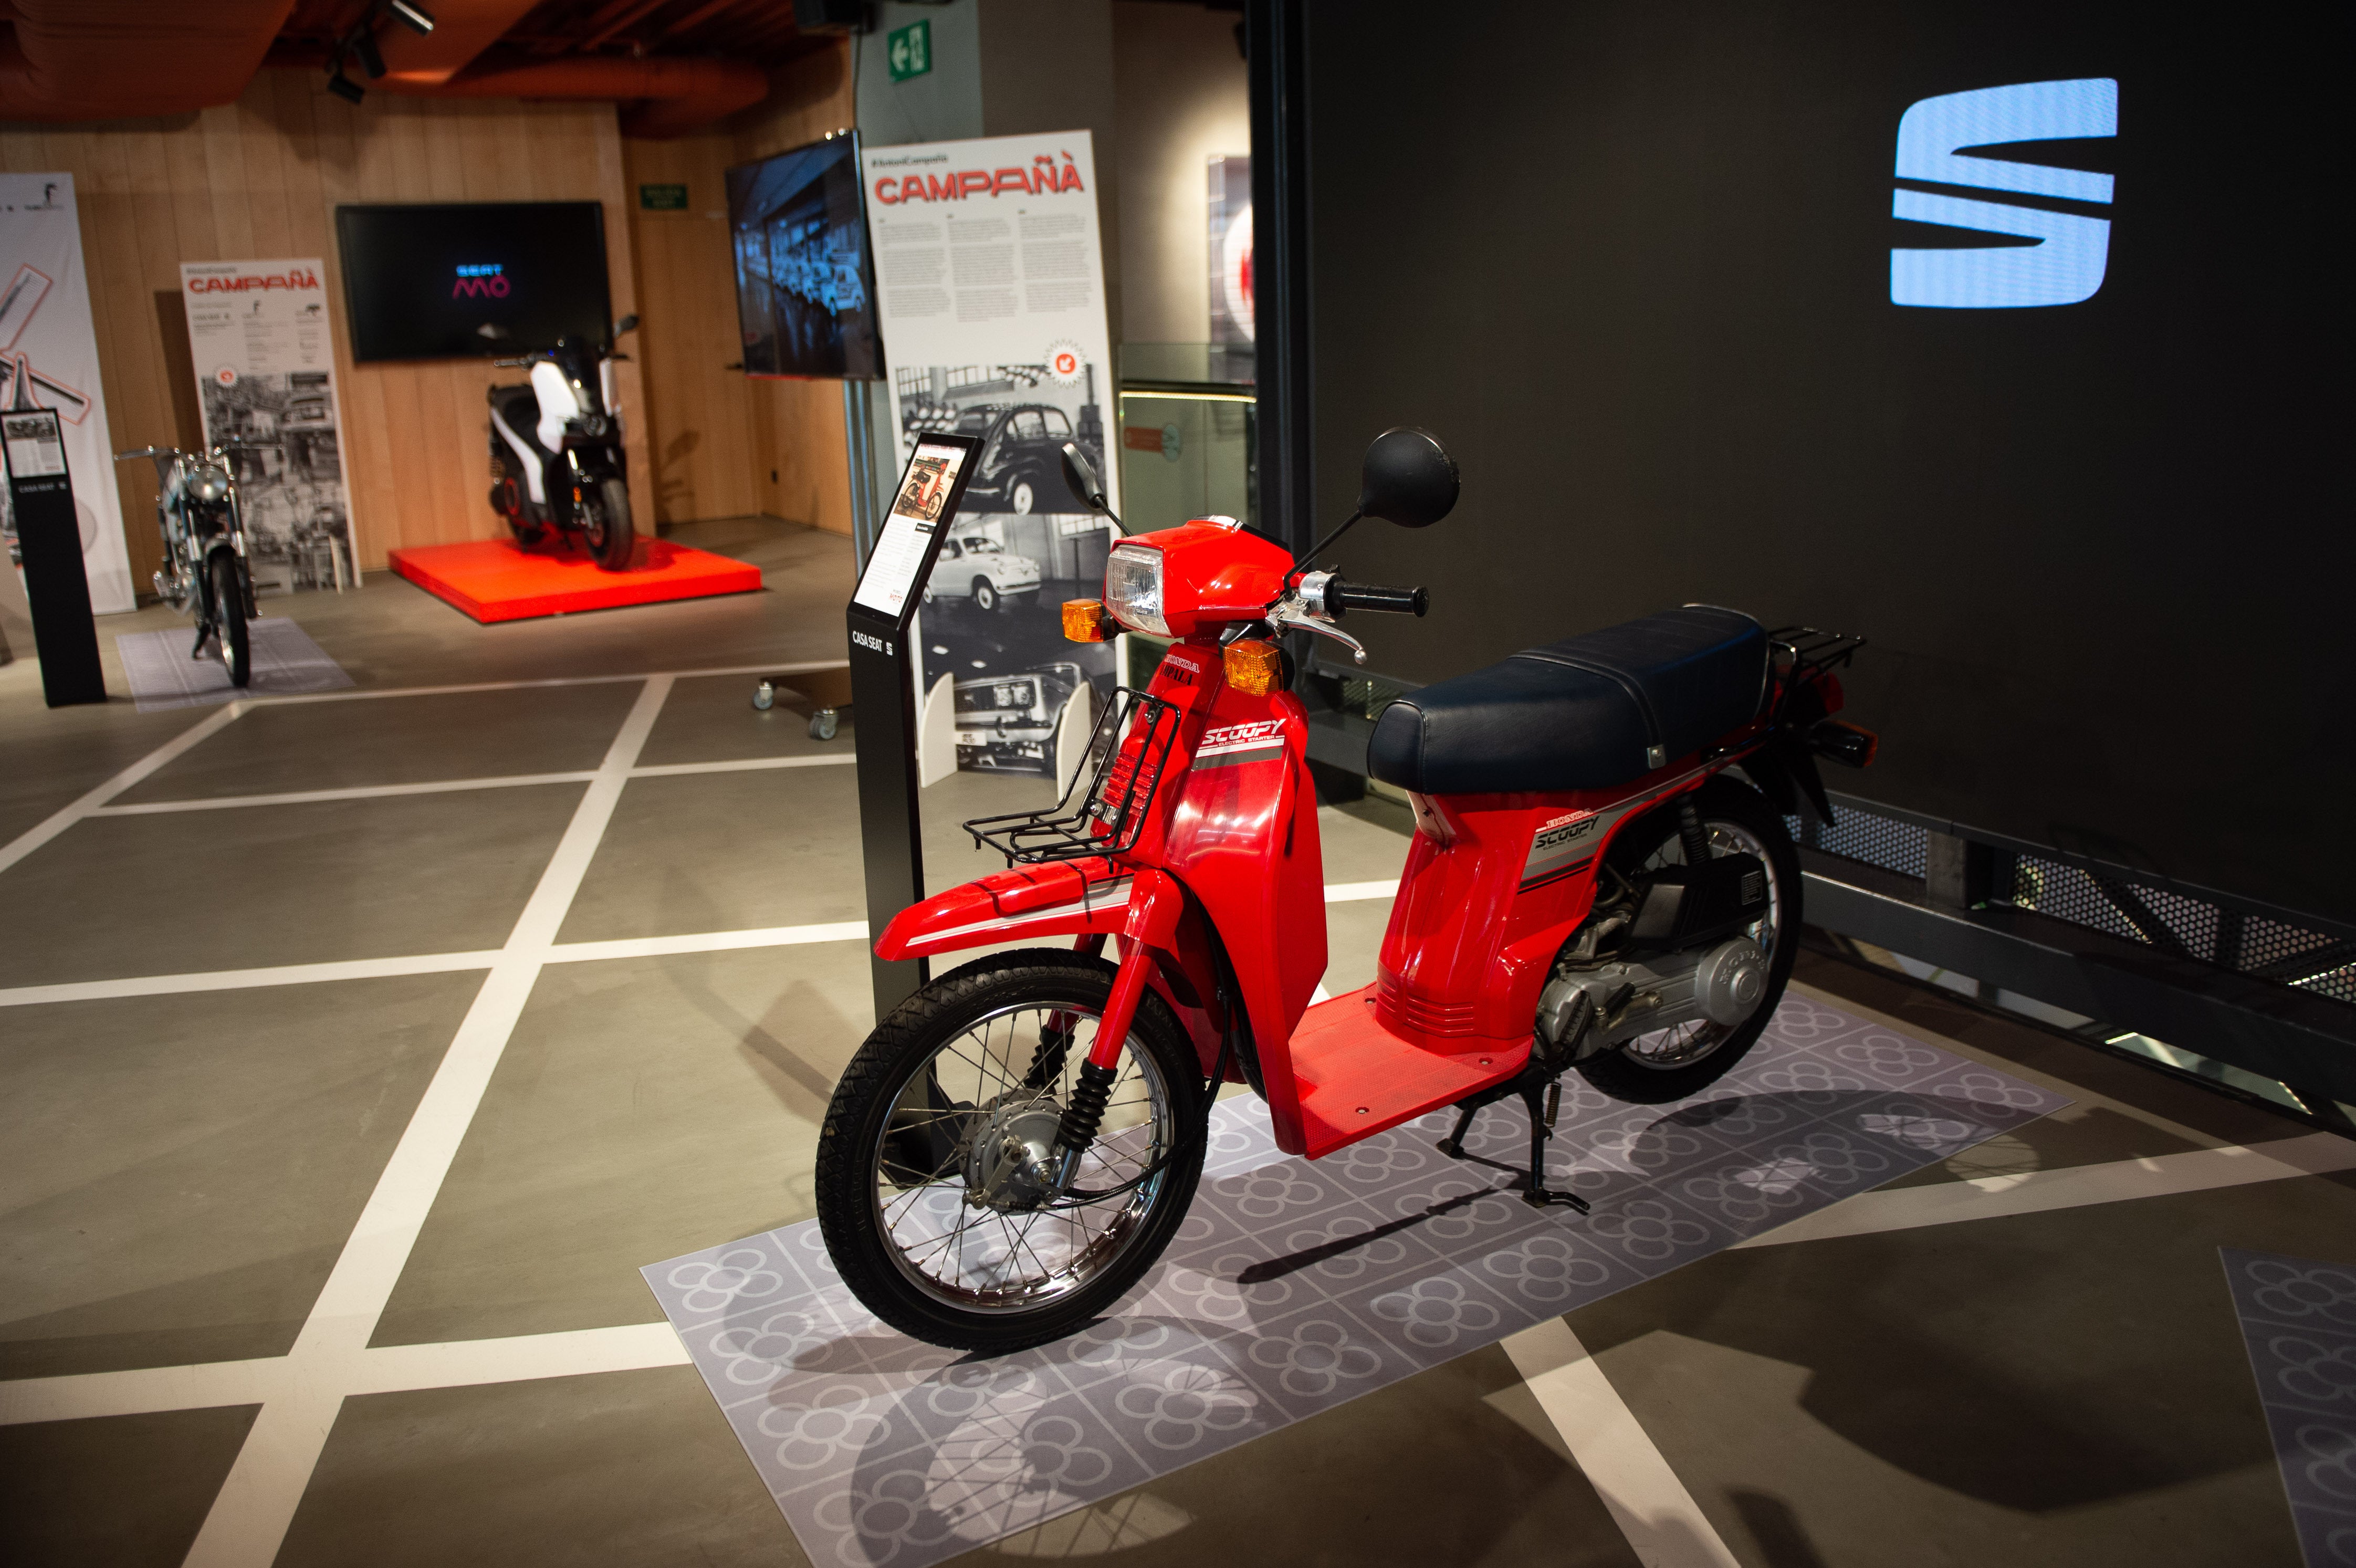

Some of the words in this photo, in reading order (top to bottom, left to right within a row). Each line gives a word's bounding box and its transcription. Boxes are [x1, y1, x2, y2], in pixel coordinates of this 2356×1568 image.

[875, 150, 1084, 205] CAMPAÑÀ
[853, 631, 868, 647] CASA
[868, 636, 882, 652] SEAT
[1165, 654, 1200, 673] HONDA
[1202, 718, 1286, 745] SCOOPY
[1218, 738, 1245, 747] ELECTRIC
[1546, 808, 1594, 829] HONDA
[1535, 816, 1600, 849] SCOOPY
